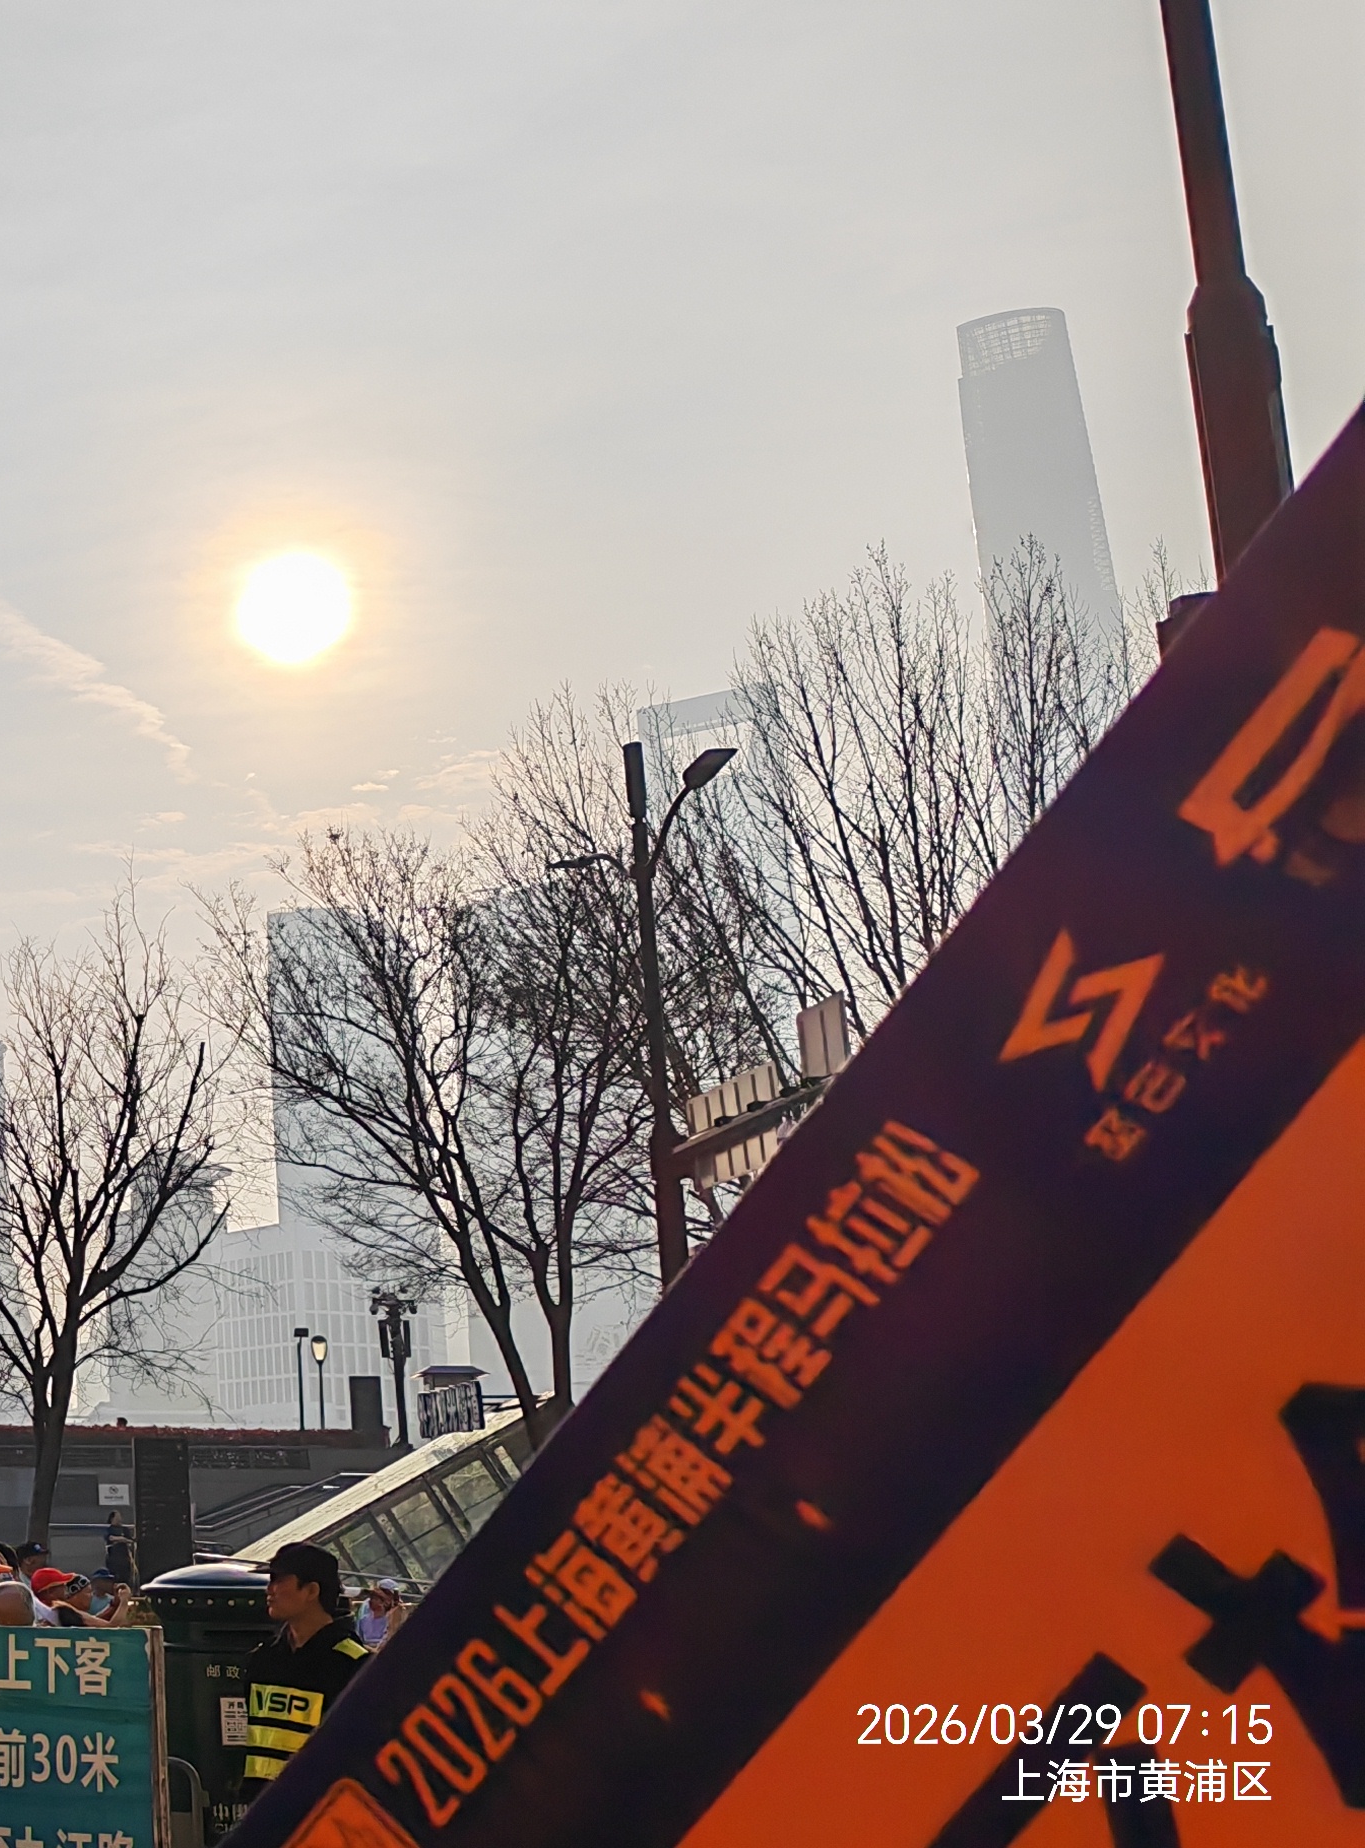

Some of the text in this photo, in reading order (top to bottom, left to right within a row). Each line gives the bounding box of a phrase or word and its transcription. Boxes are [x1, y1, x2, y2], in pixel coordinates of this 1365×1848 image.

[376, 1120, 980, 1829] 2026上海黄浦半程马拉松
[206, 1664, 241, 1680] 邮政
[255, 1689, 310, 1715] VSP
